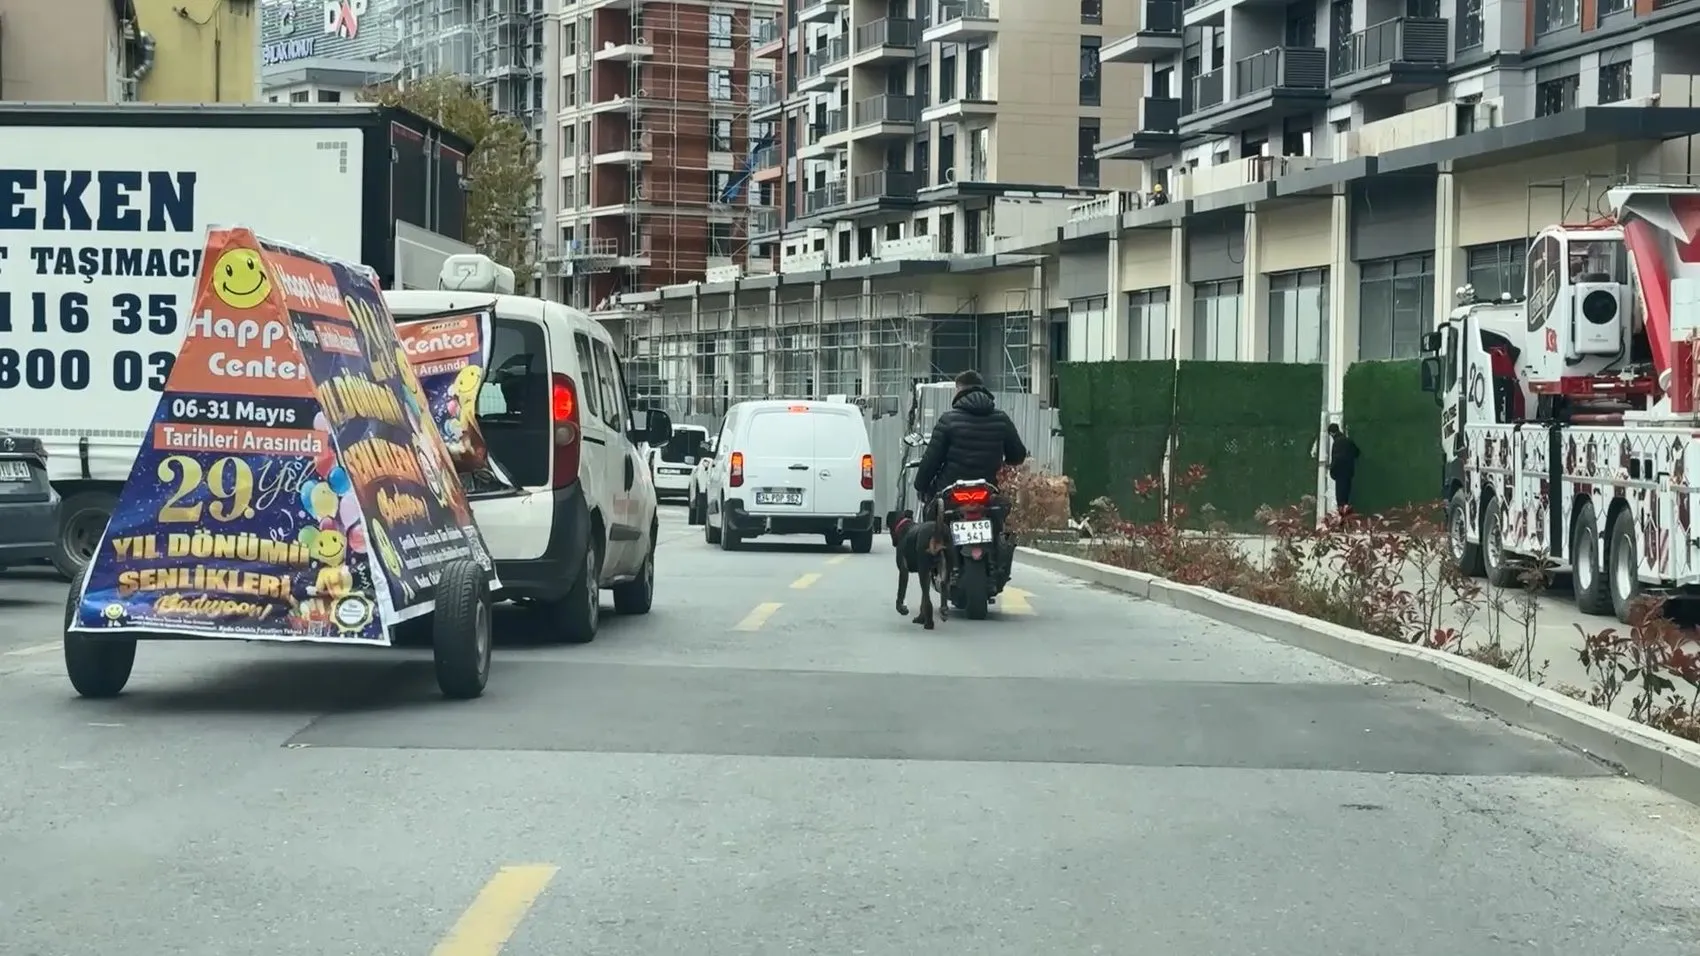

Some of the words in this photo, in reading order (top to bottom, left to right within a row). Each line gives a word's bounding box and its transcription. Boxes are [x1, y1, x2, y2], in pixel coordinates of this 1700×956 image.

[112, 293, 177, 335] 35
[187, 309, 286, 349] Happ
[403, 332, 475, 355] Center
[172, 399, 230, 419] 06-31
[236, 403, 296, 426] Mayıs
[163, 427, 239, 450] Tarihleri
[243, 434, 322, 453] Arasında
[954, 523, 966, 532] 34
